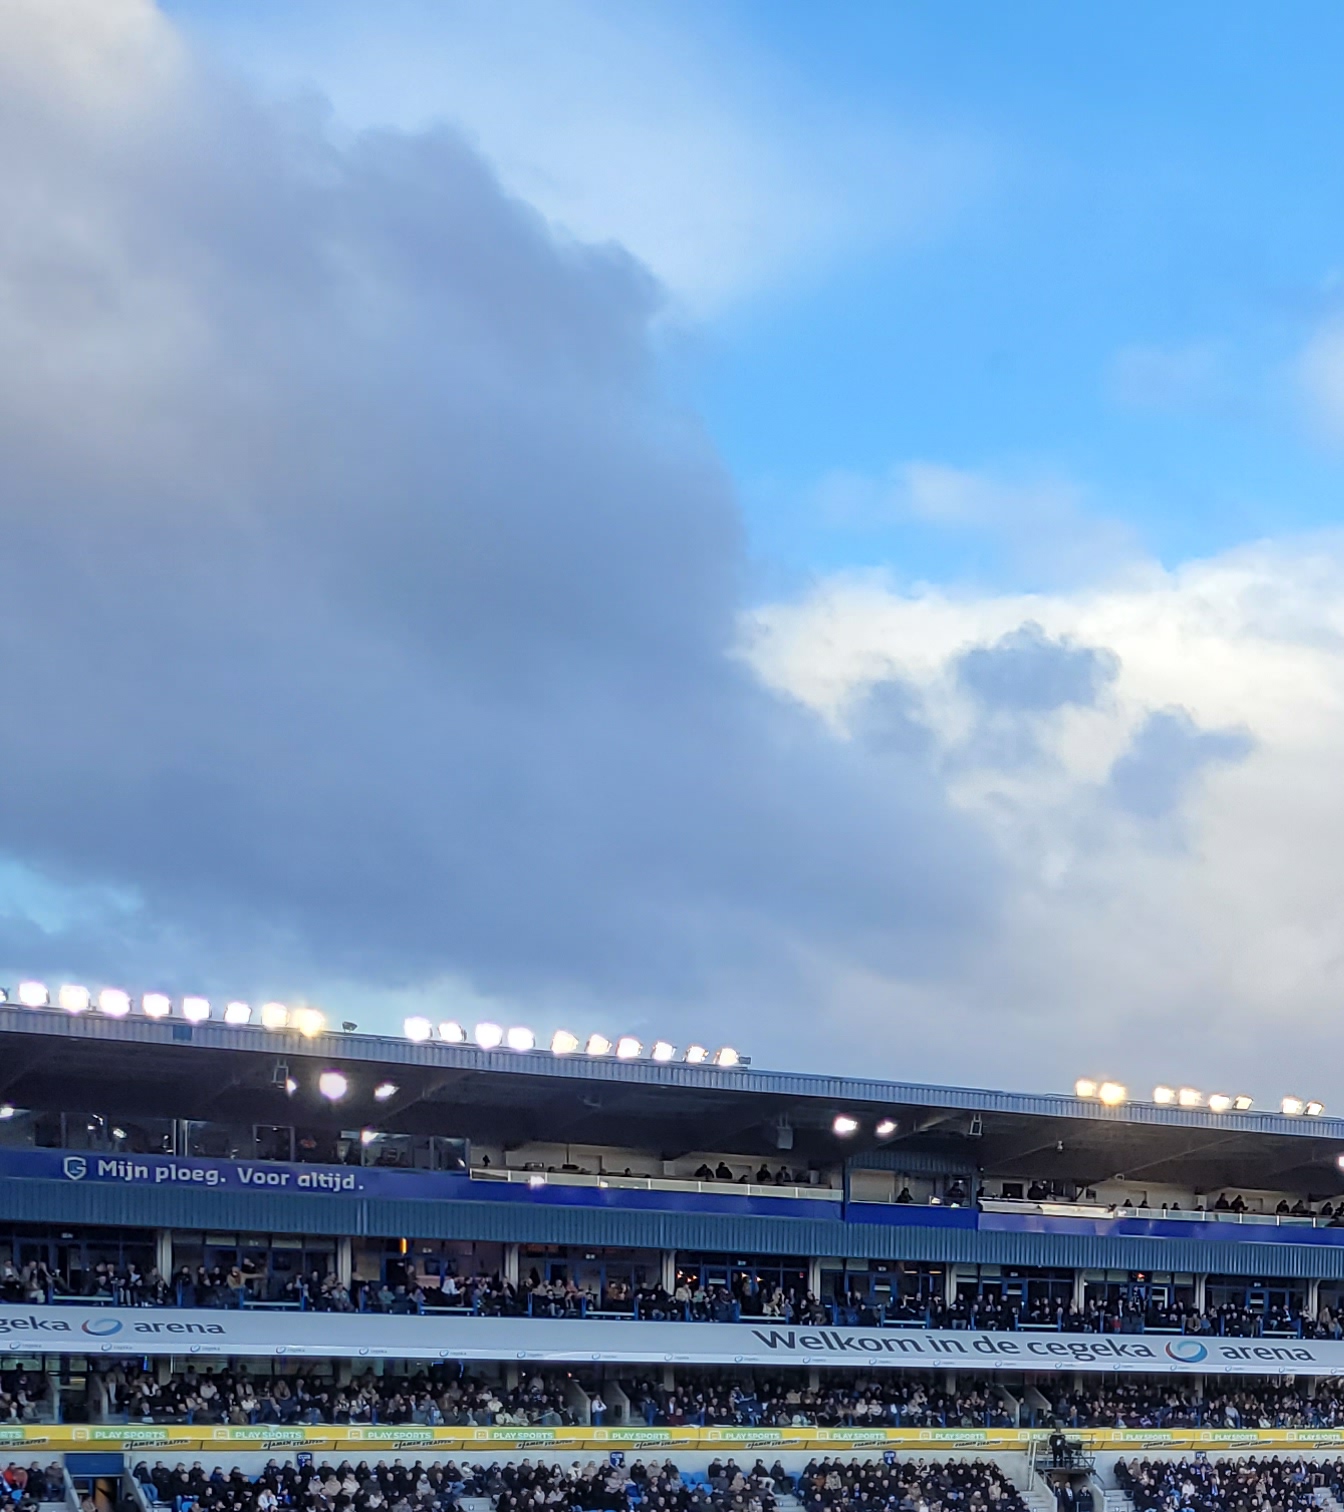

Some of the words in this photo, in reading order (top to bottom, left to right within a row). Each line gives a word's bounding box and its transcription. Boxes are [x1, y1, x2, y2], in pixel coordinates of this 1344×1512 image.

[98, 1160, 148, 1182] Mijn
[155, 1164, 226, 1187] ploeg.
[237, 1167, 290, 1185] Voor
[297, 1171, 365, 1192] altijd.
[134, 1321, 226, 1334] arena
[751, 1328, 924, 1355] Welkom
[927, 1334, 964, 1355] in
[972, 1335, 1019, 1357] de
[1027, 1338, 1157, 1363] cegeka
[1220, 1343, 1316, 1363] arena
[95, 1431, 121, 1439] PLAY
[123, 1431, 166, 1439] SPORTS
